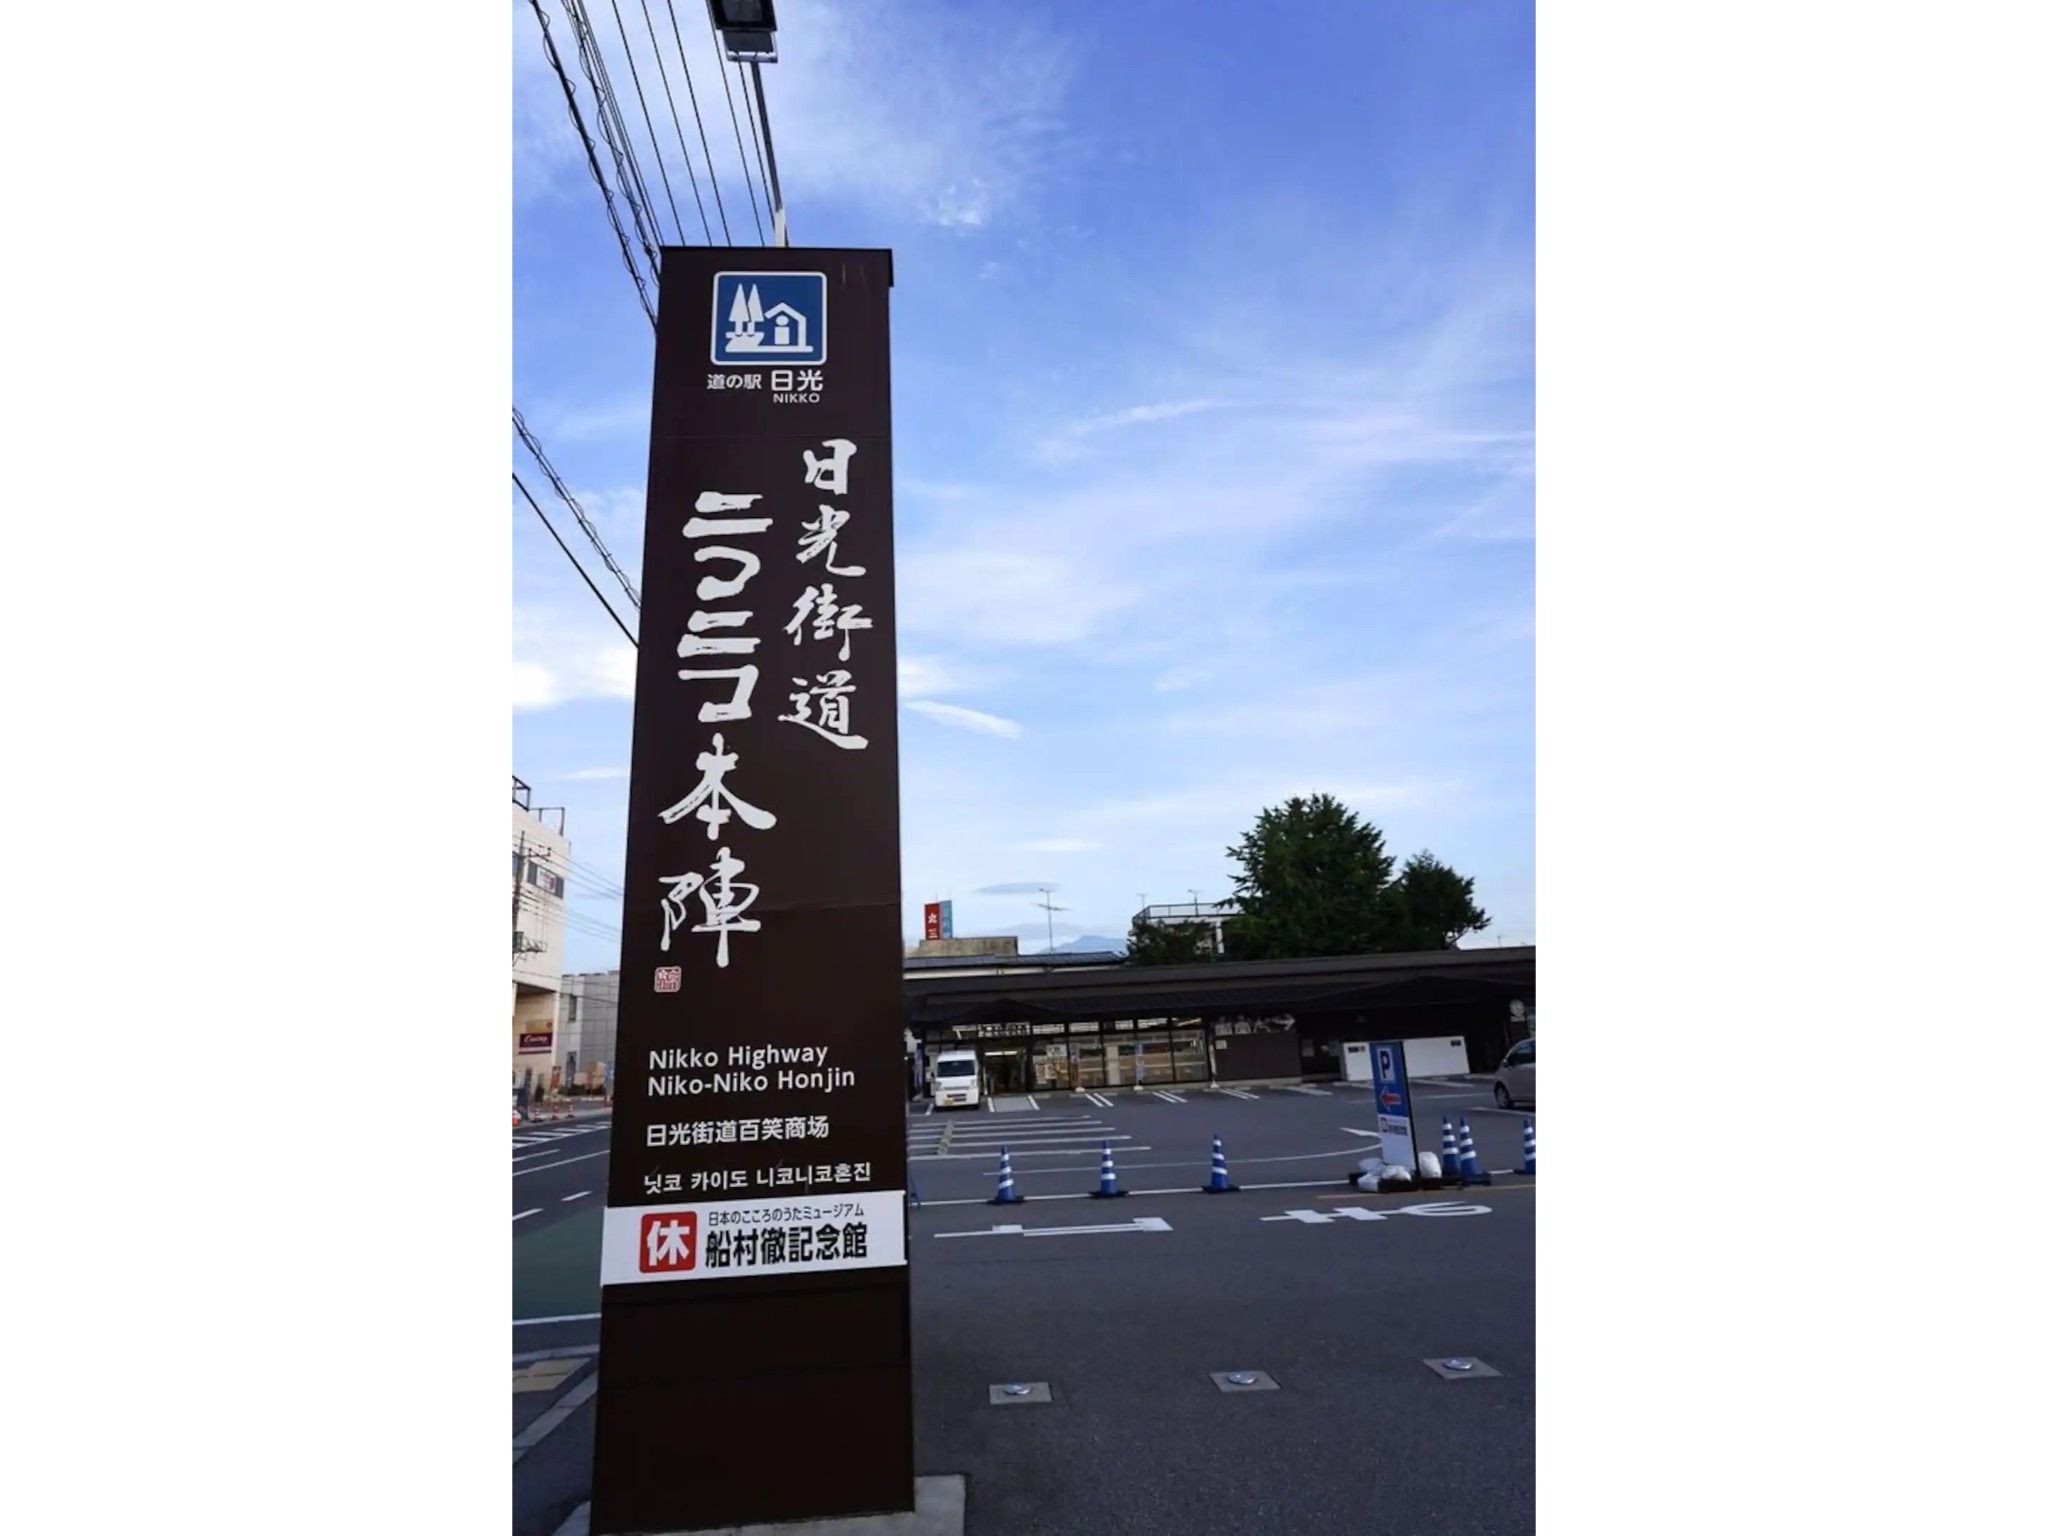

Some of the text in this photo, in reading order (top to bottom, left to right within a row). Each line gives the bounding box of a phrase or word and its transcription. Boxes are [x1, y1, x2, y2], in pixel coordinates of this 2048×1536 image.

[707, 369, 824, 392] 道の駅 日光
[773, 392, 821, 404] NIKKO
[777, 439, 874, 750] 日光街道
[658, 491, 776, 968] ニコニコ本陣
[649, 1044, 828, 1070] Nikko Highway
[1380, 1050, 1391, 1079] P
[648, 1067, 855, 1096] Niko-Niko Honjin
[646, 1115, 829, 1147] 日光街道百笑商场
[644, 1162, 871, 1195] 닛코 카이도 니코니코혼진
[708, 1203, 864, 1226] 日本のこころのうたミュージアム
[647, 1220, 690, 1266] 休
[705, 1221, 868, 1268] 船村徹記念館
